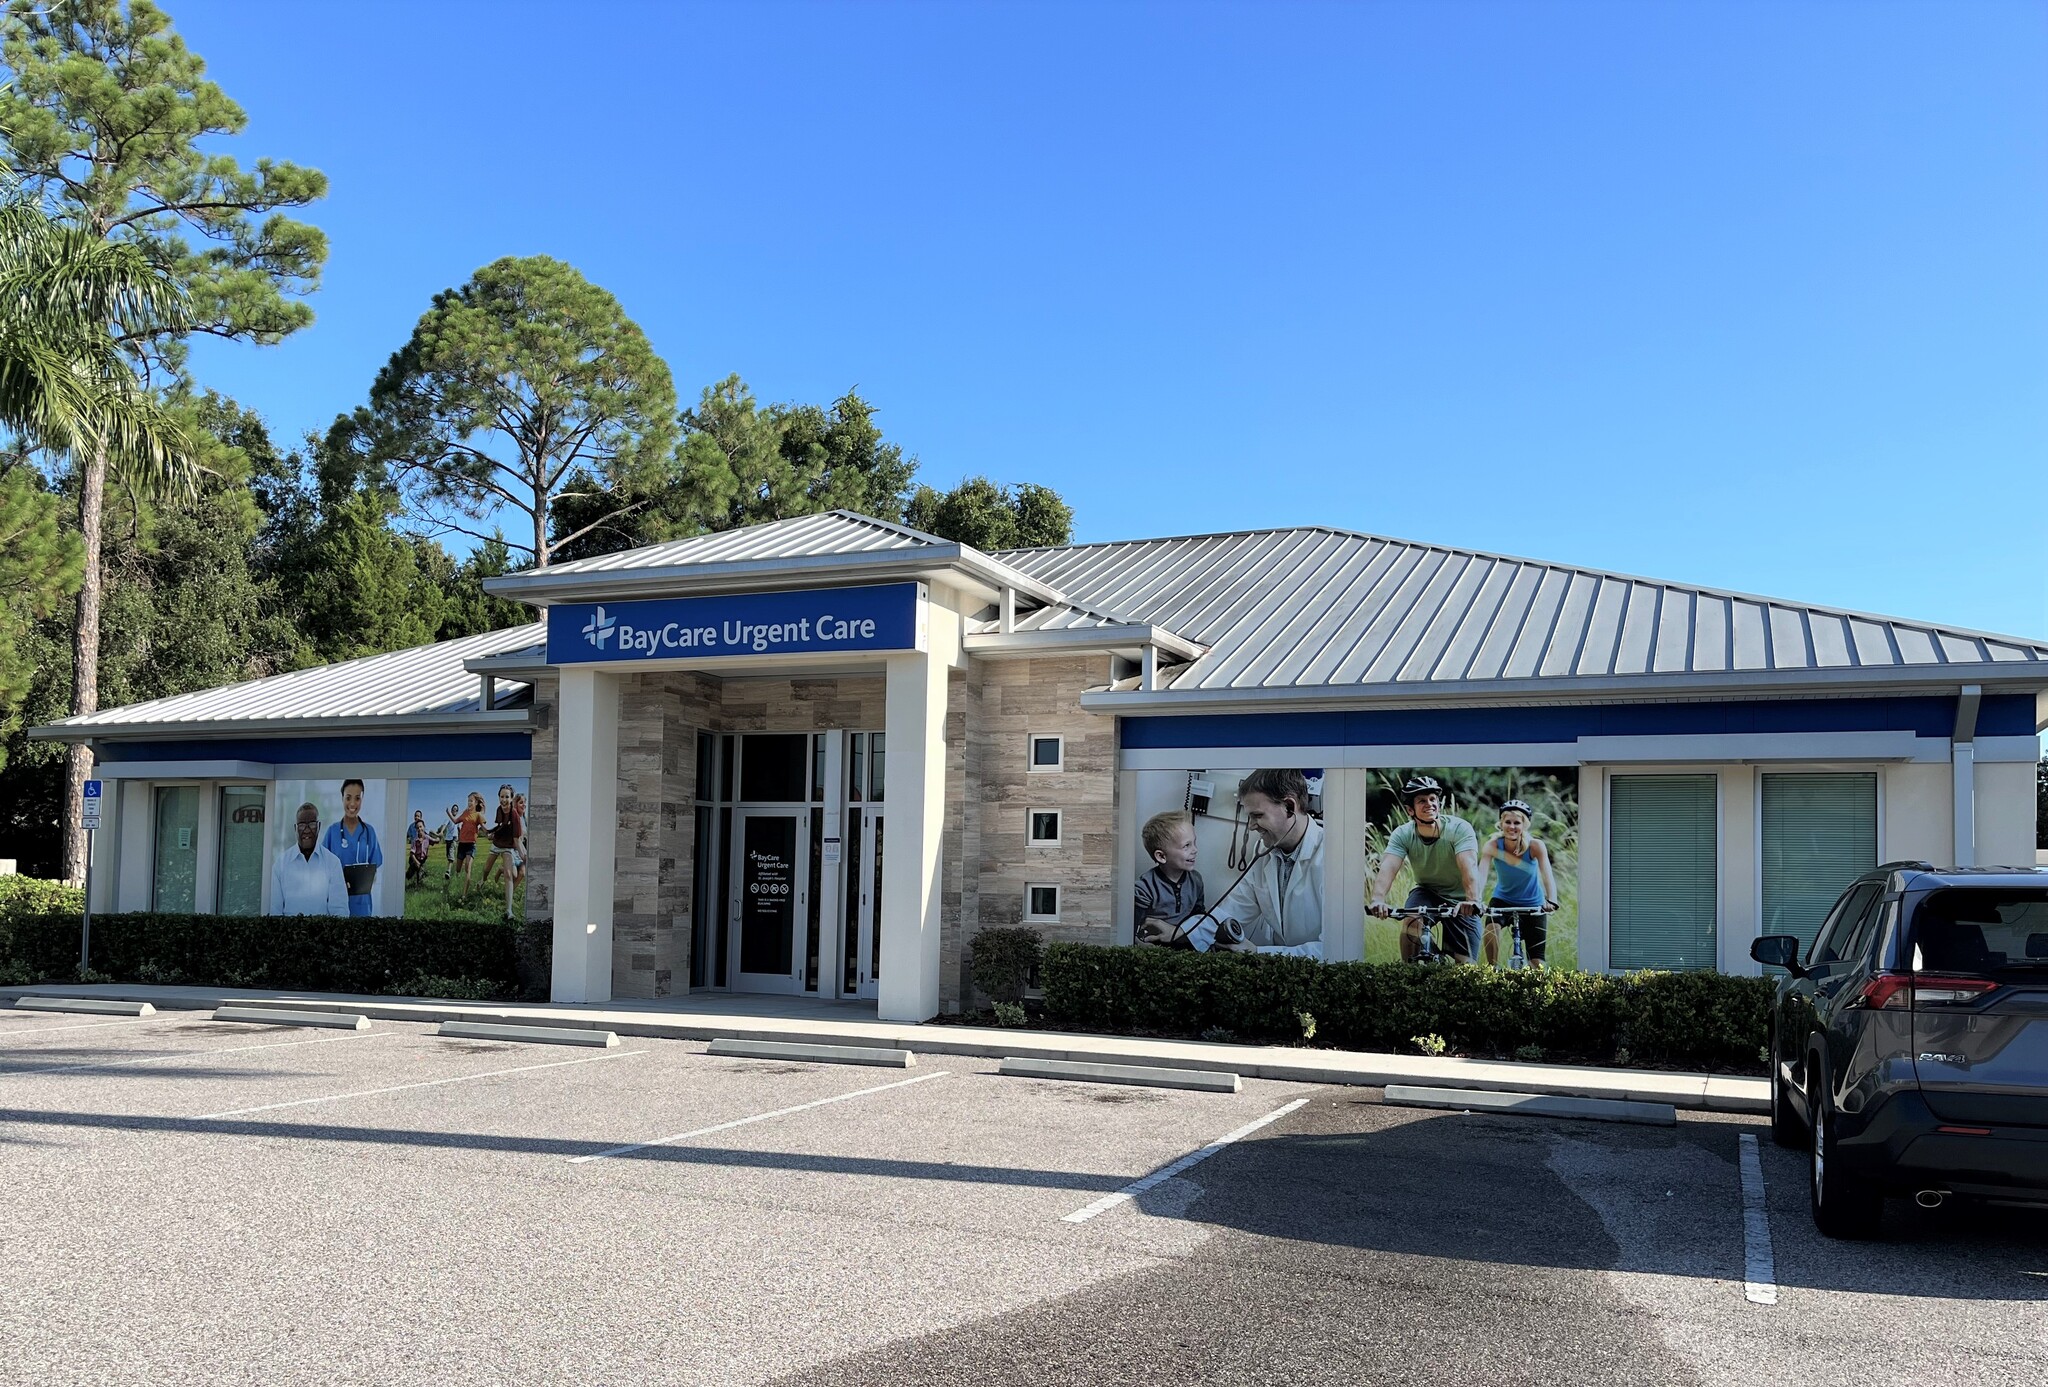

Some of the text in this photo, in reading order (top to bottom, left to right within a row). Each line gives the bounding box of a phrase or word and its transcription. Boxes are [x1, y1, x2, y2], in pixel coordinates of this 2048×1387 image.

[618, 615, 876, 656] BayCare Urgent Care
[232, 808, 264, 823] OPEN
[757, 854, 779, 862] BayCare
[757, 861, 789, 869] Urgent Care
[1918, 1053, 1965, 1063] RAV4
